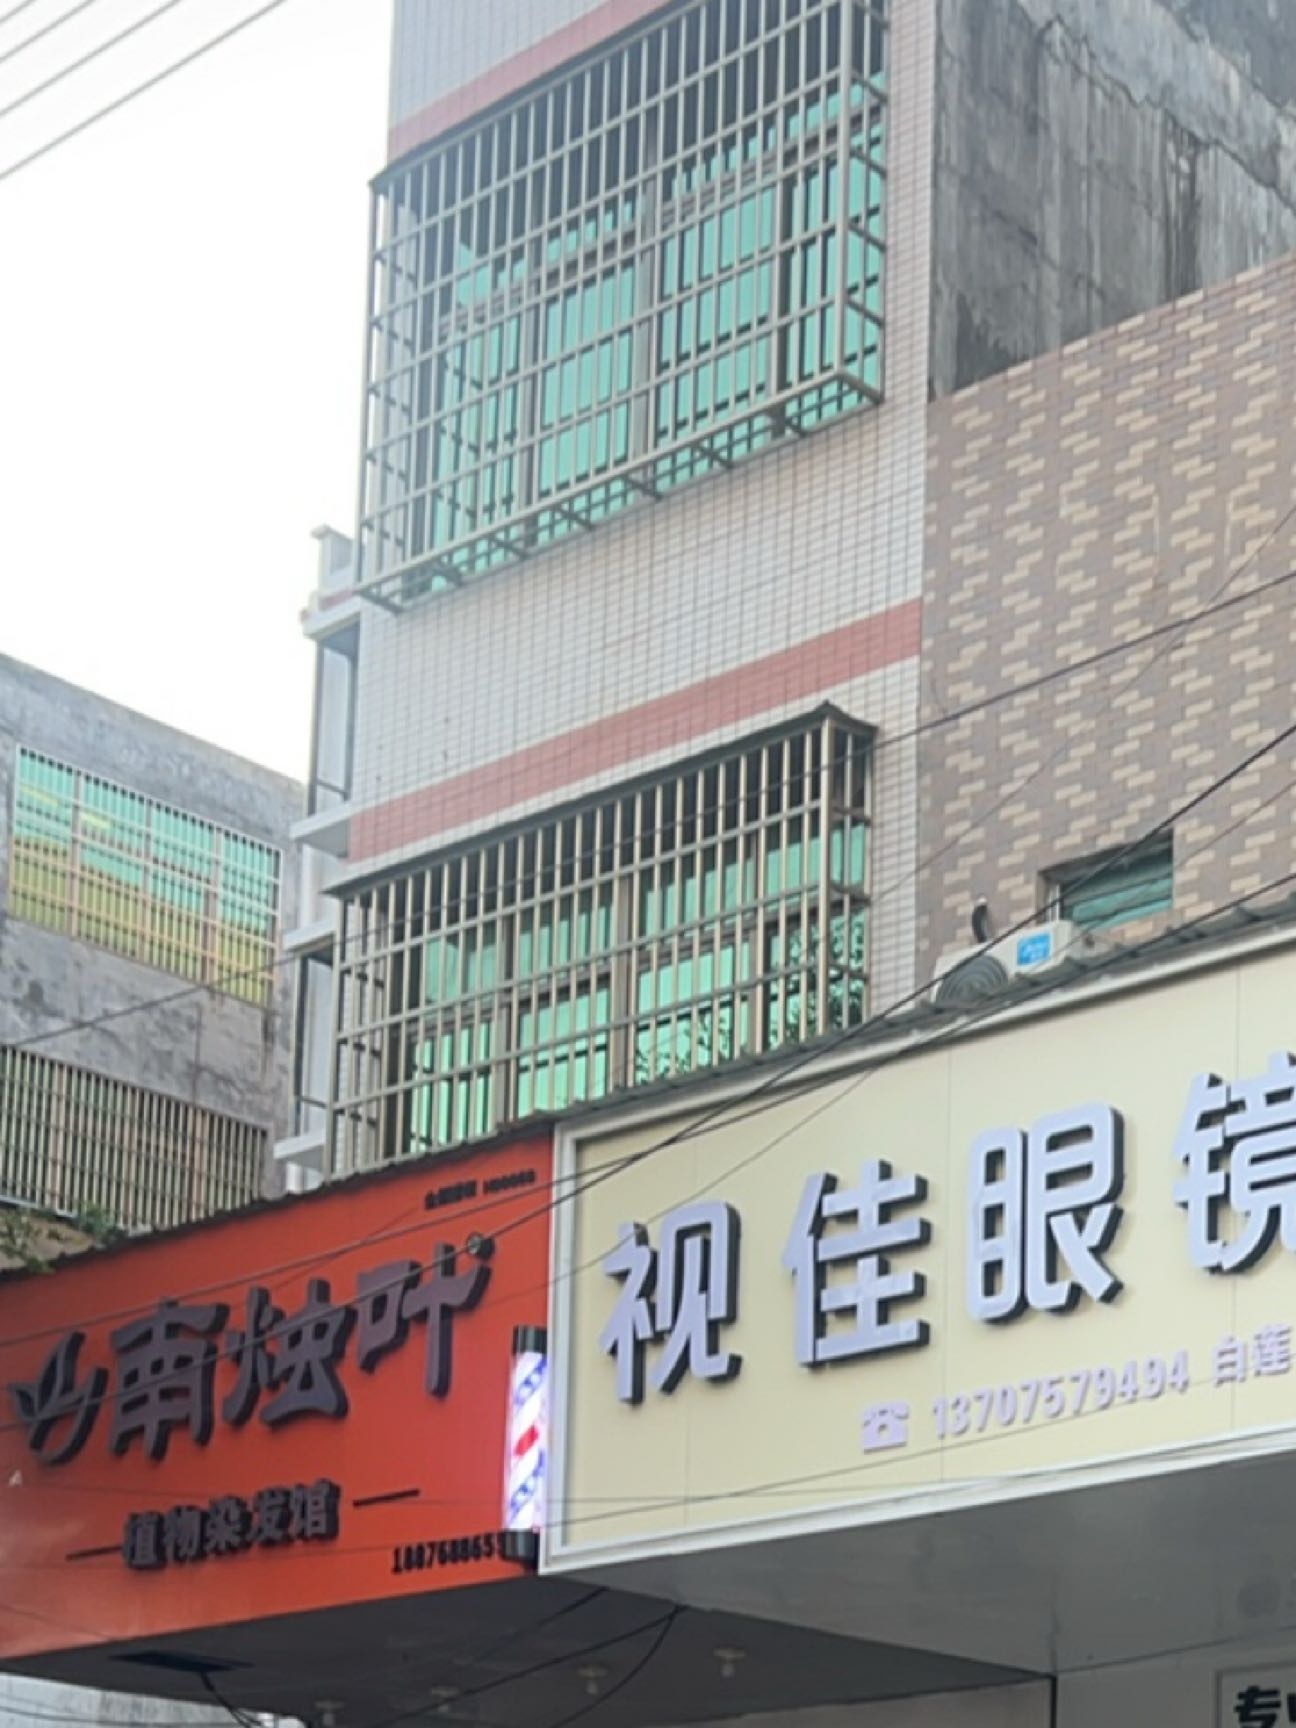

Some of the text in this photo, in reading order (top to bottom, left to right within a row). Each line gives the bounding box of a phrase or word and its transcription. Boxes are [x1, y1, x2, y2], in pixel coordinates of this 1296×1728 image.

[933, 1350, 1190, 1440] 13707579494
[124, 1480, 341, 1570] 植物染发馆
